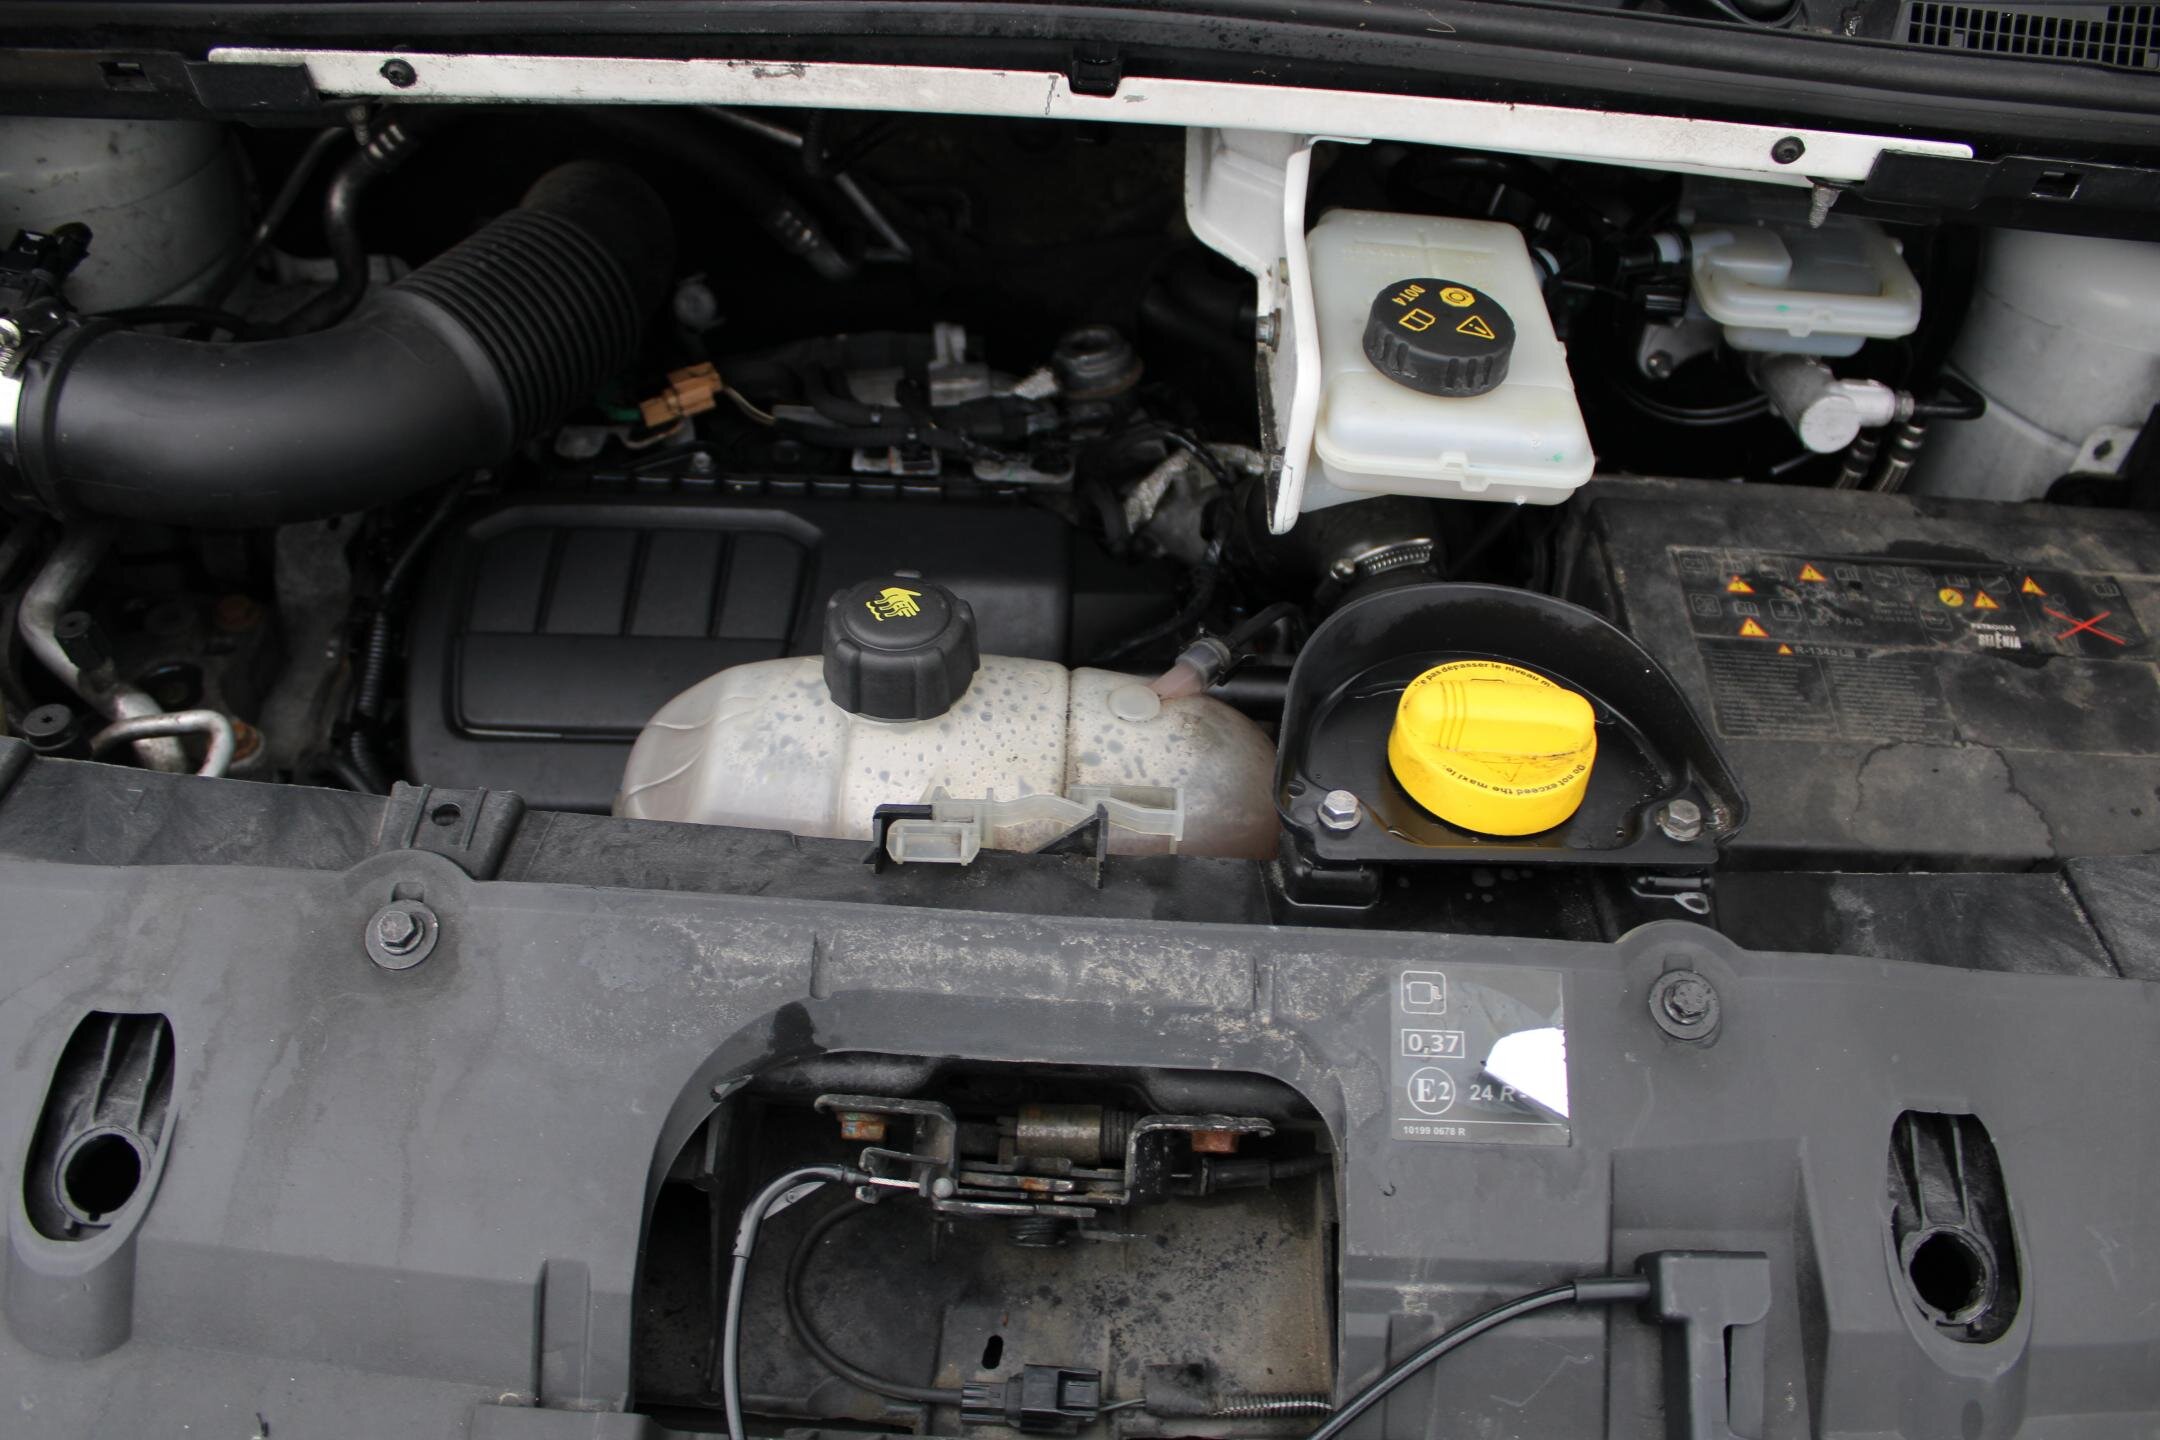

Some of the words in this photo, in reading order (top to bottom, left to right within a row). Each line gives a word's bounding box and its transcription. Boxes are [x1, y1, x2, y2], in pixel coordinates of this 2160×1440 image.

[1408, 1033, 1459, 1054] 0,37
[1415, 1077, 1450, 1103] E2
[1469, 1084, 1494, 1101] 24
[1458, 1128, 1466, 1136] R
